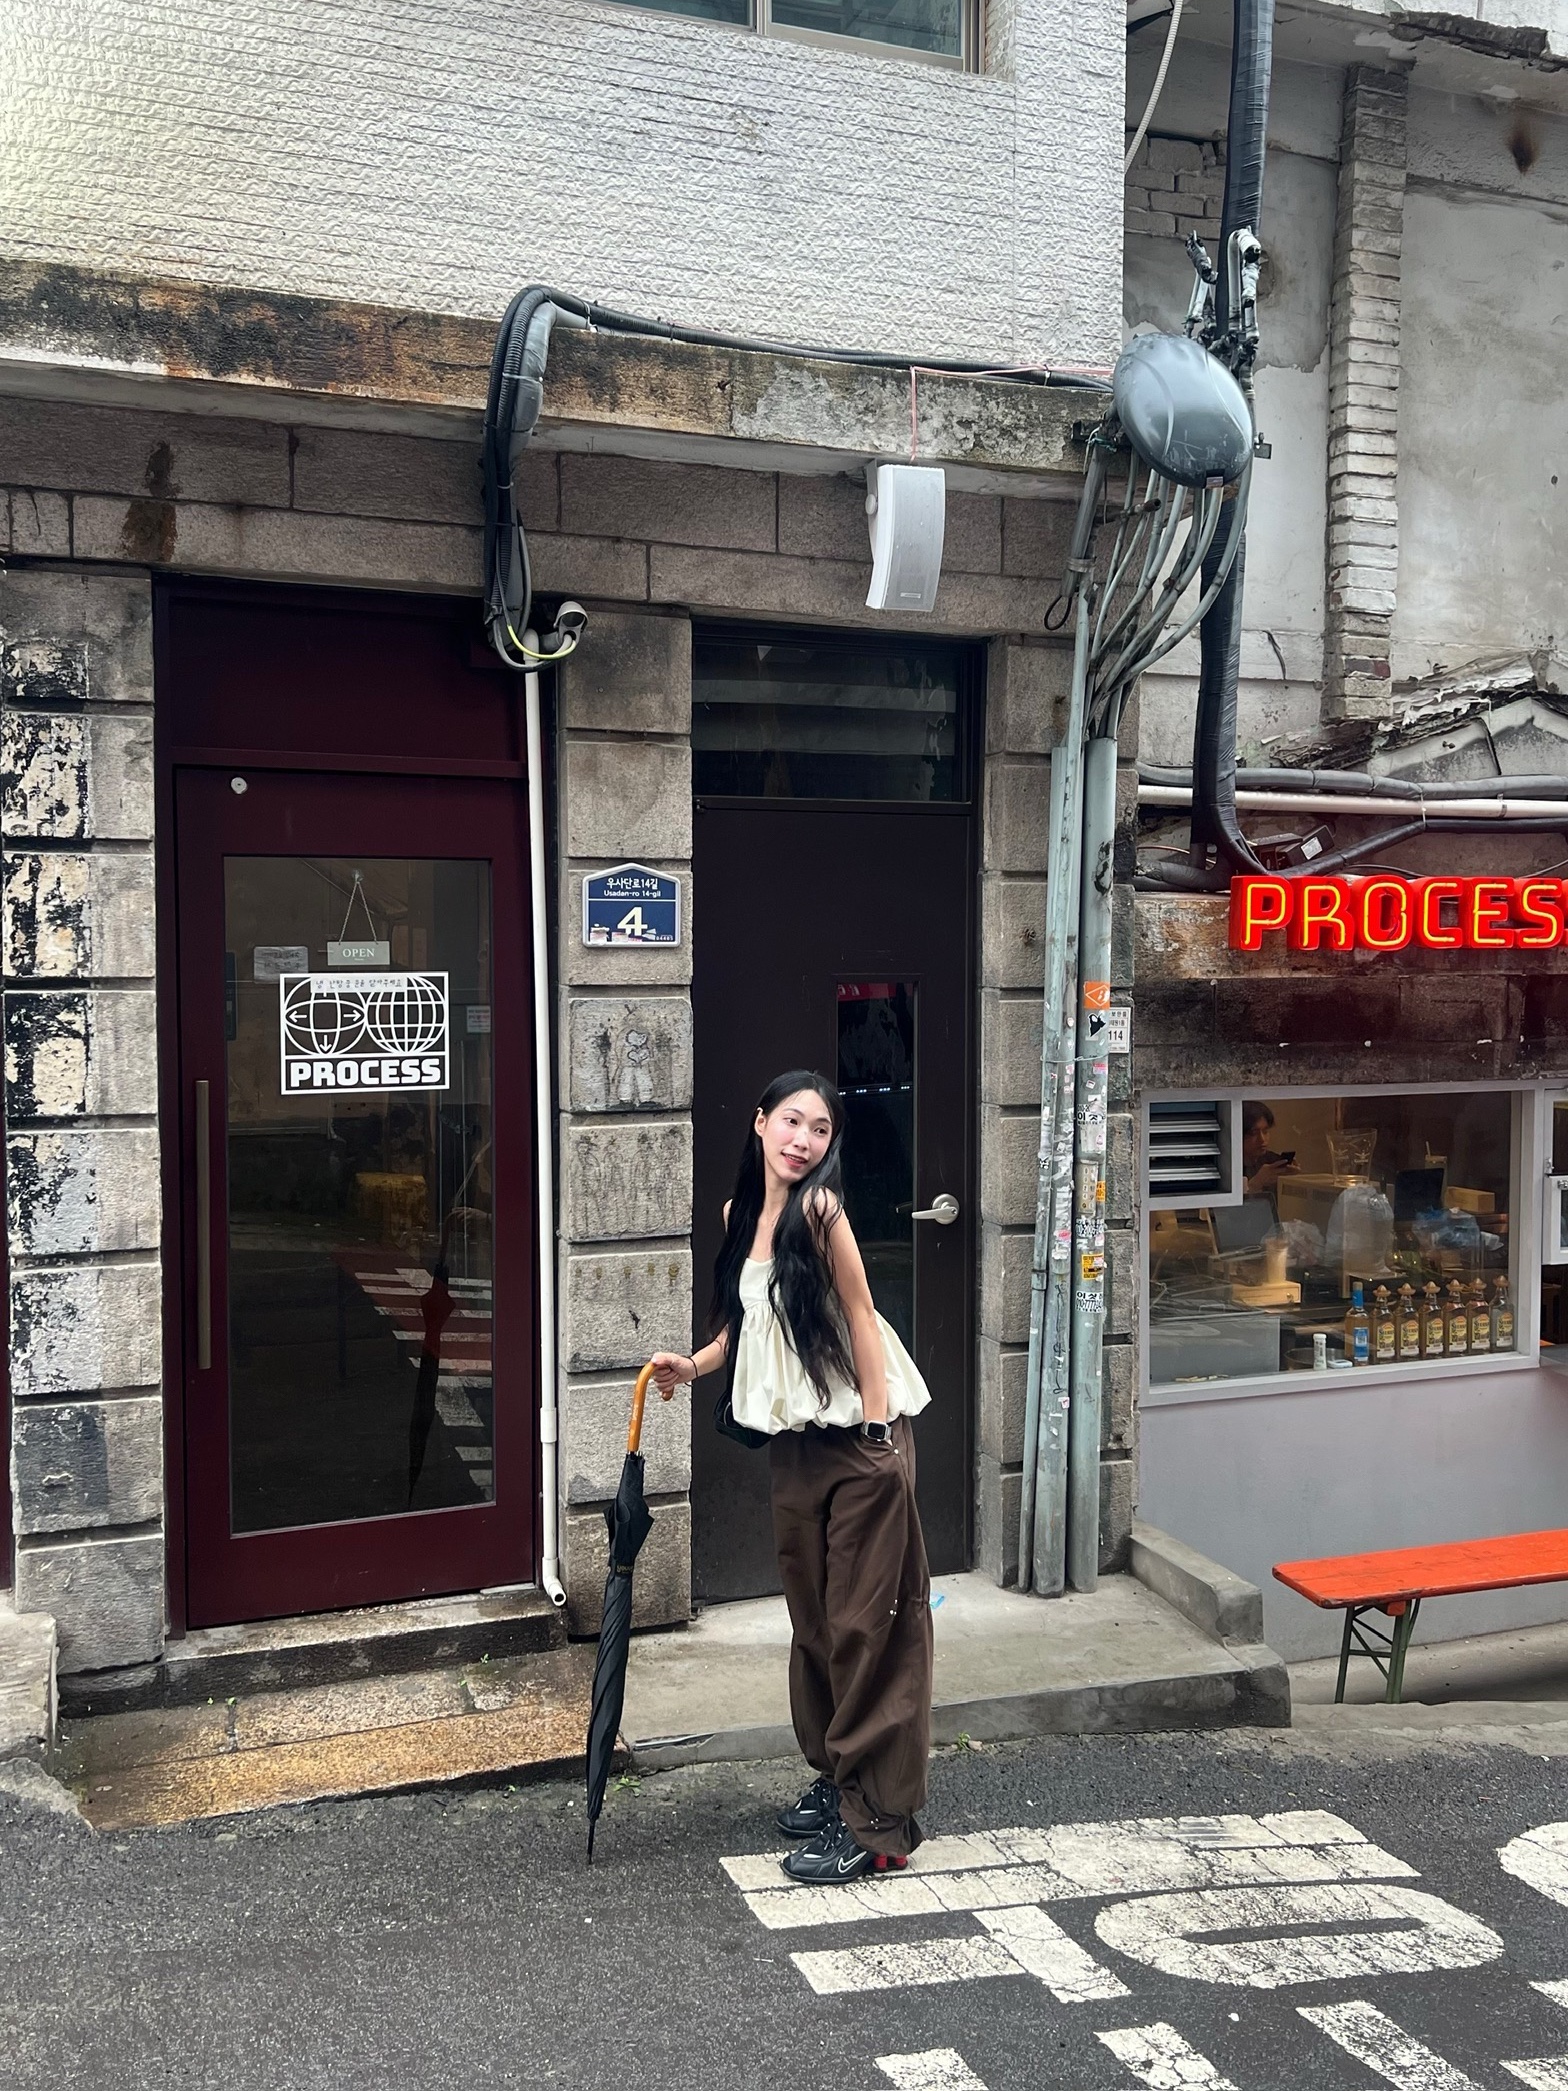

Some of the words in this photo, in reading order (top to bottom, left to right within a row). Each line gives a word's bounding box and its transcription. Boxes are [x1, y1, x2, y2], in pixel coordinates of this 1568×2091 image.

[603, 889, 640, 897] Usadan-ro
[642, 889, 661, 898] 14-gil
[606, 877, 658, 890] 우사단로14길
[617, 906, 648, 936] 4
[1228, 874, 1568, 951] PROCES
[342, 947, 375, 958] OPEN
[290, 1058, 441, 1088] PROCESS
